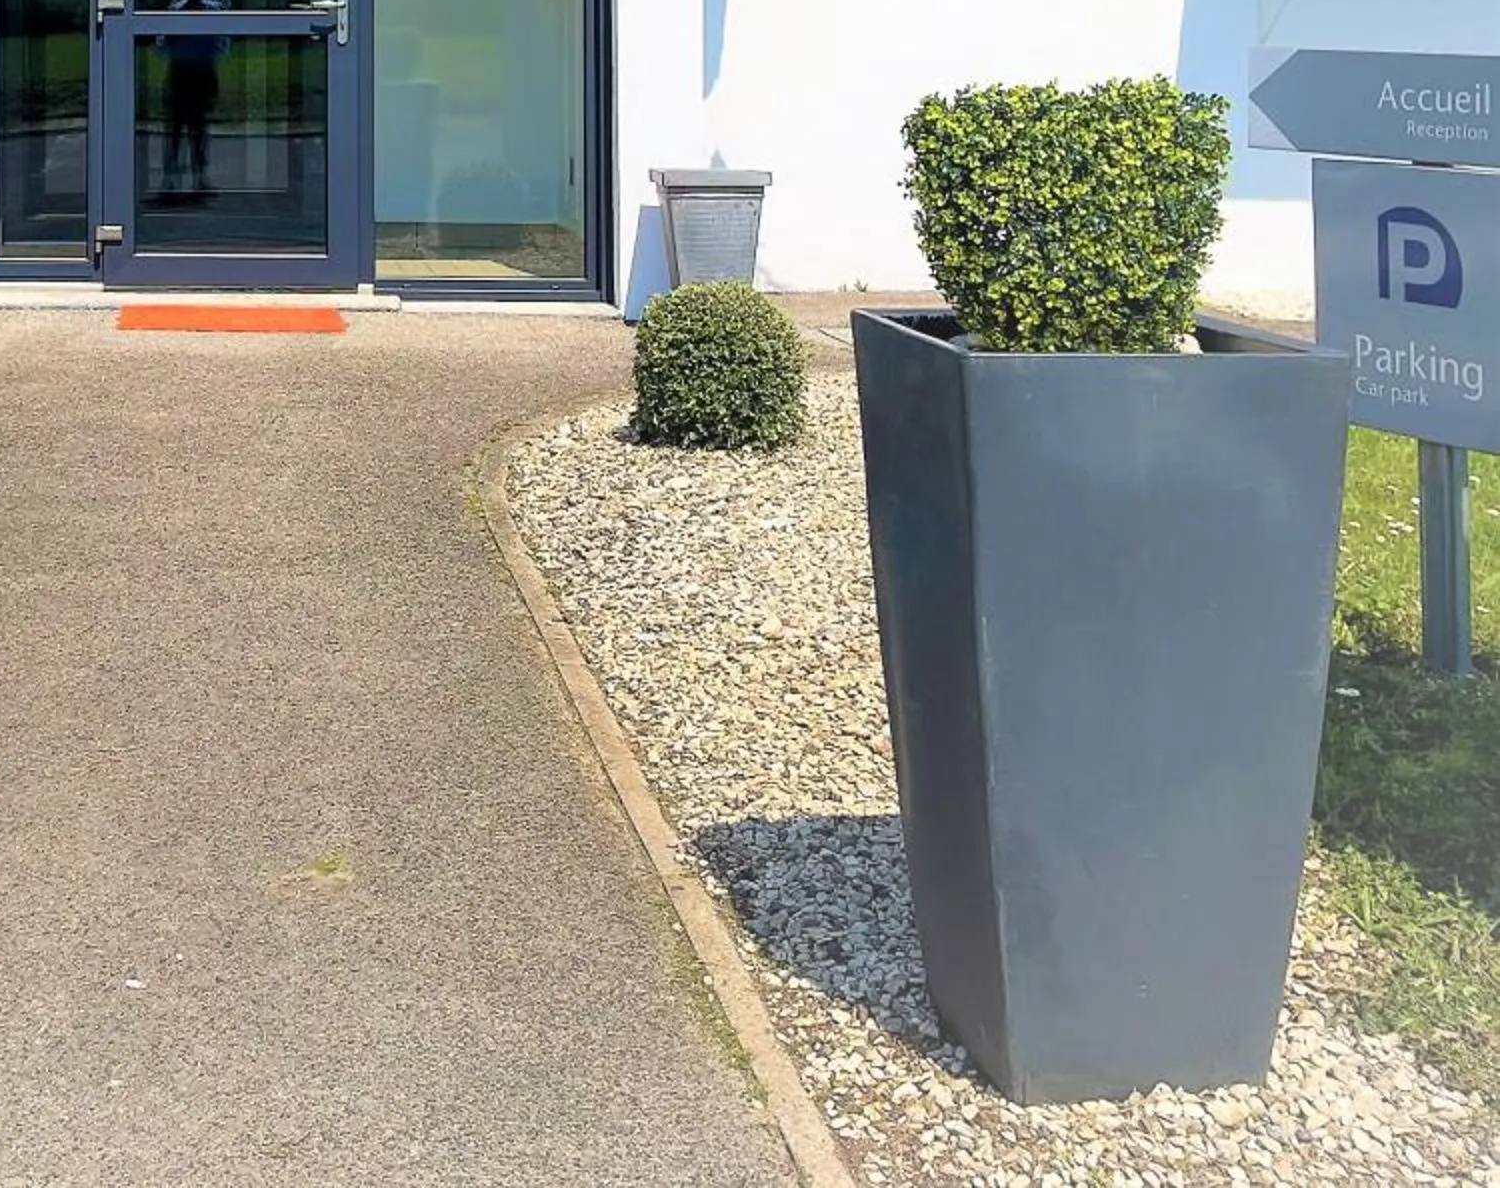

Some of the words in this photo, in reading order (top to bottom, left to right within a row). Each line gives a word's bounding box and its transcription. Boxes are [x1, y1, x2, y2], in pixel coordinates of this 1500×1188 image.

[1377, 79, 1490, 115] Accueil
[1406, 118, 1489, 142] Reception
[1386, 219, 1449, 303] P
[1355, 333, 1483, 402] Parking
[1355, 375, 1384, 397] Car
[1391, 385, 1429, 409] park
